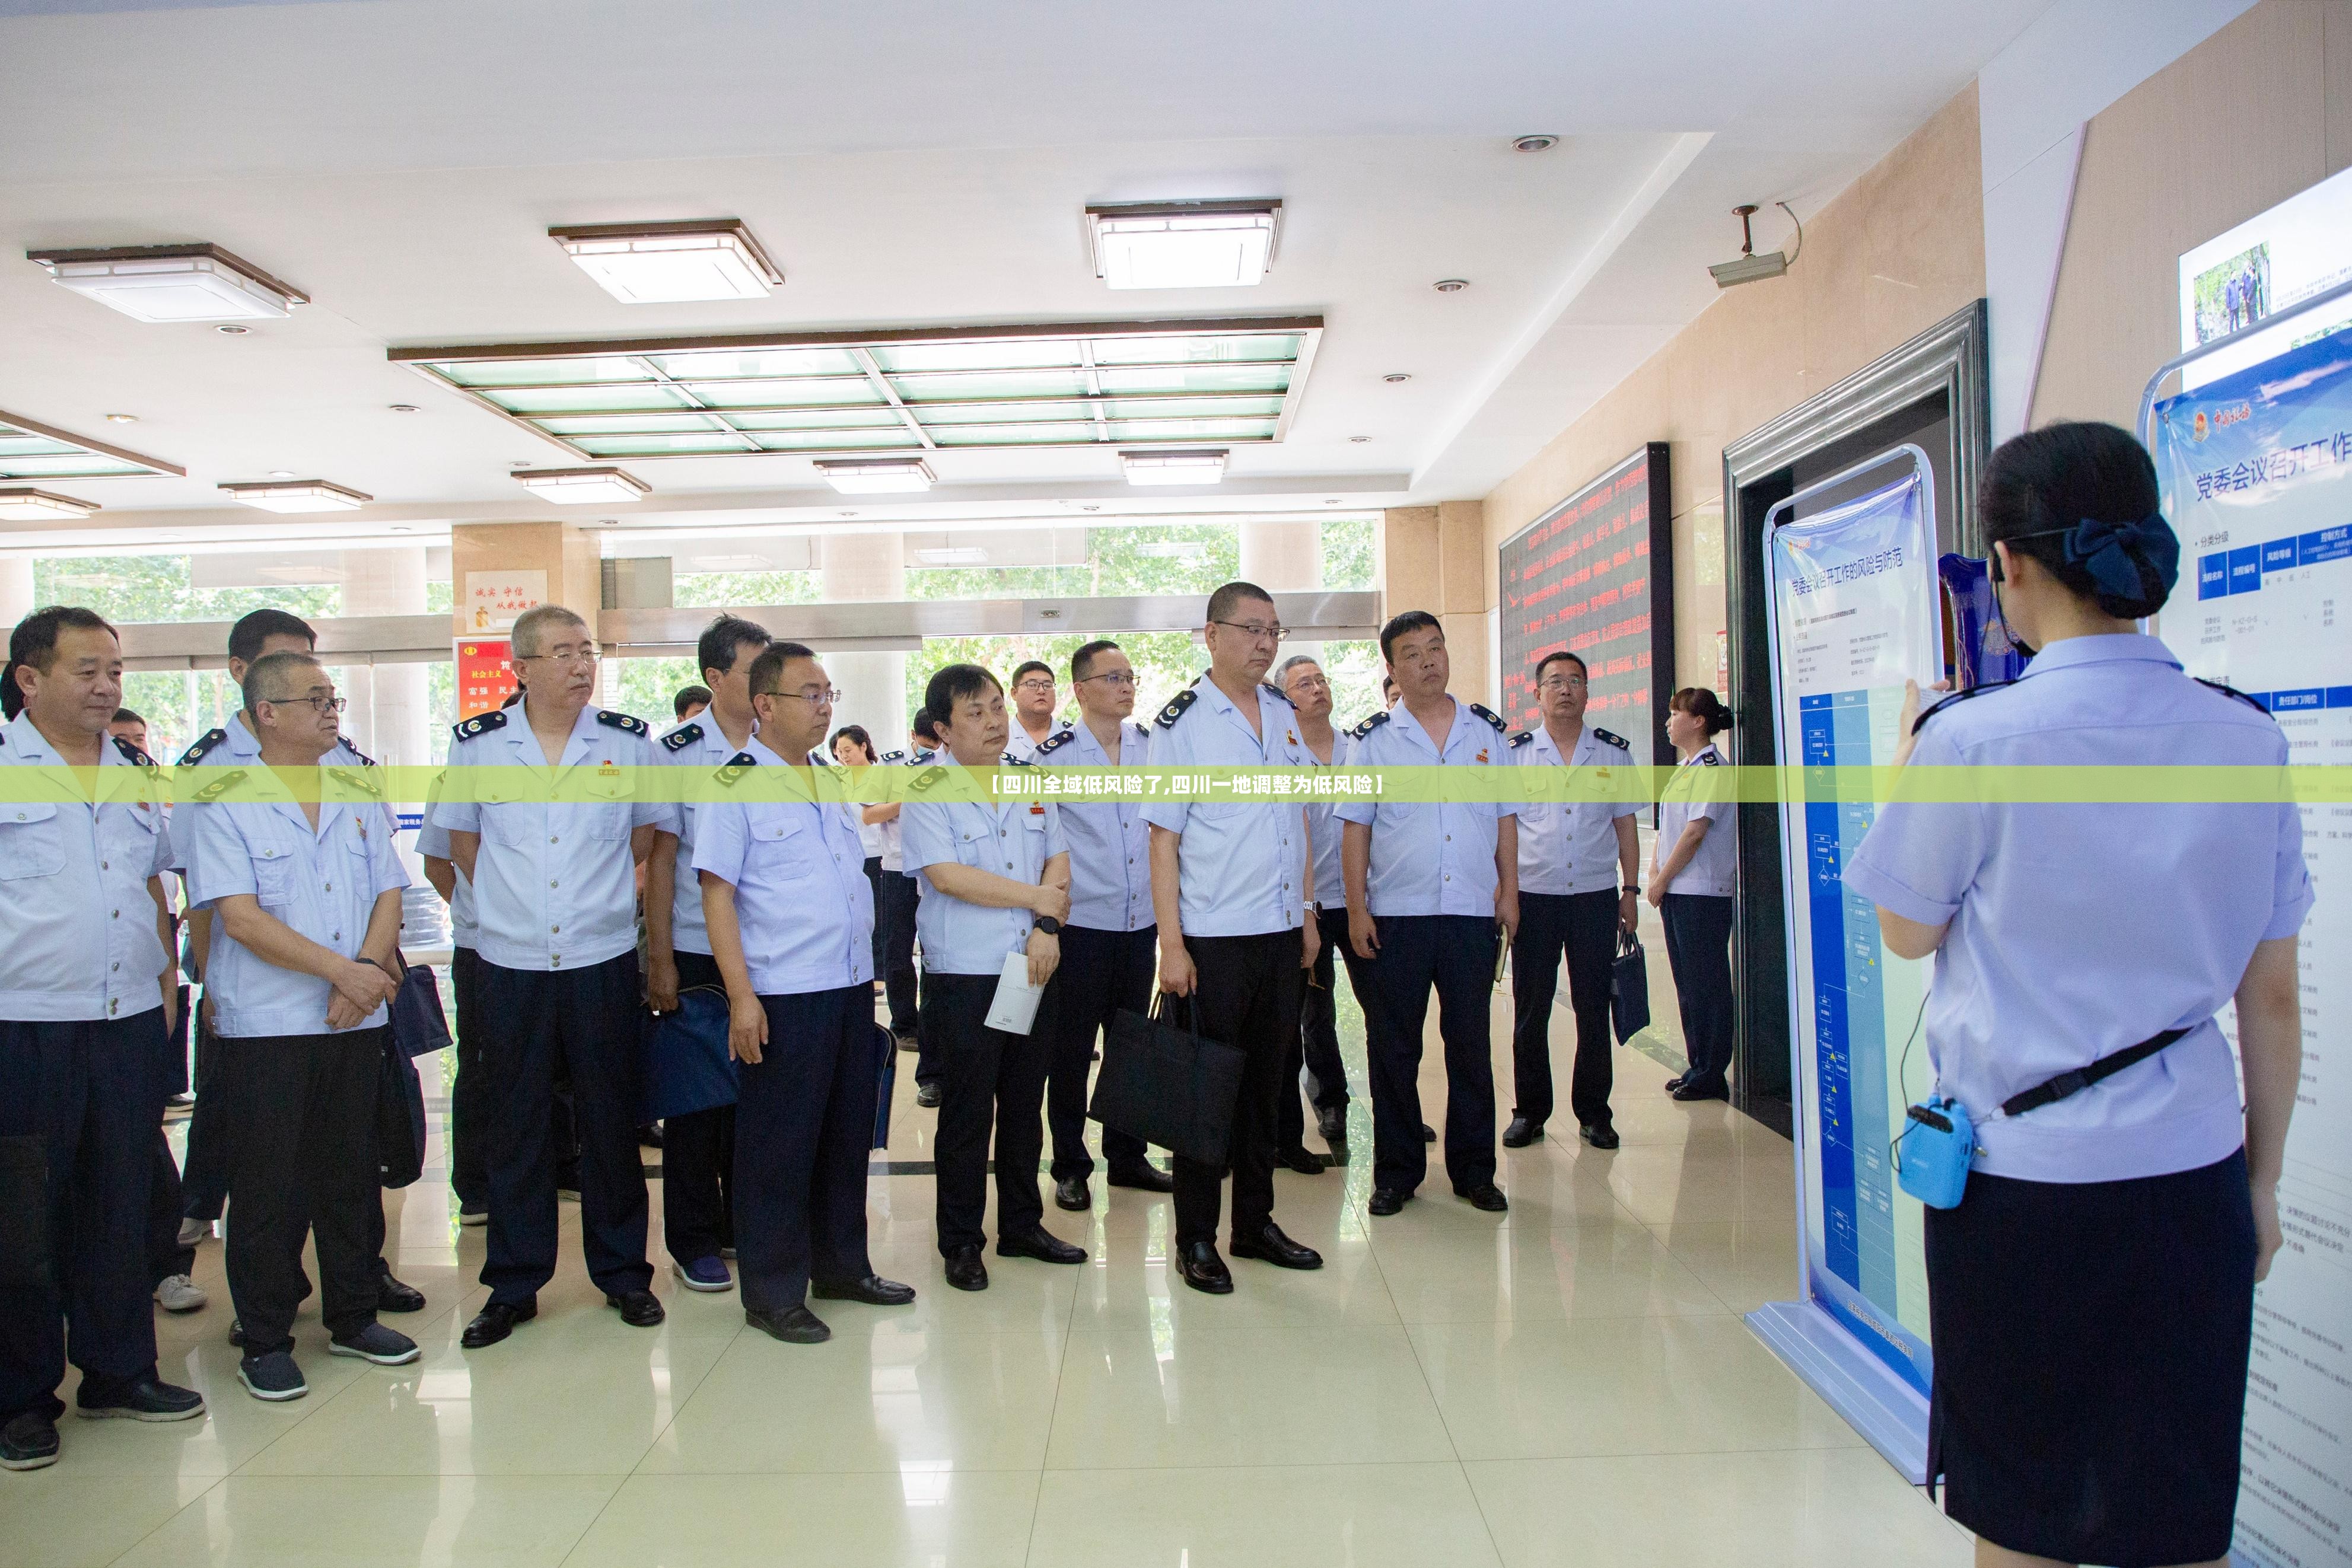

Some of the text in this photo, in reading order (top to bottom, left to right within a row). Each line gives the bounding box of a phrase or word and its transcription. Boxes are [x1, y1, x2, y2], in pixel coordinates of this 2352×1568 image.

[2200, 531, 2229, 548] 分类分级
[1791, 546, 1903, 597] 党委会议召开工作的风险与防范
[472, 670, 501, 679] 社会主义
[469, 686, 517, 696] 富强 民主
